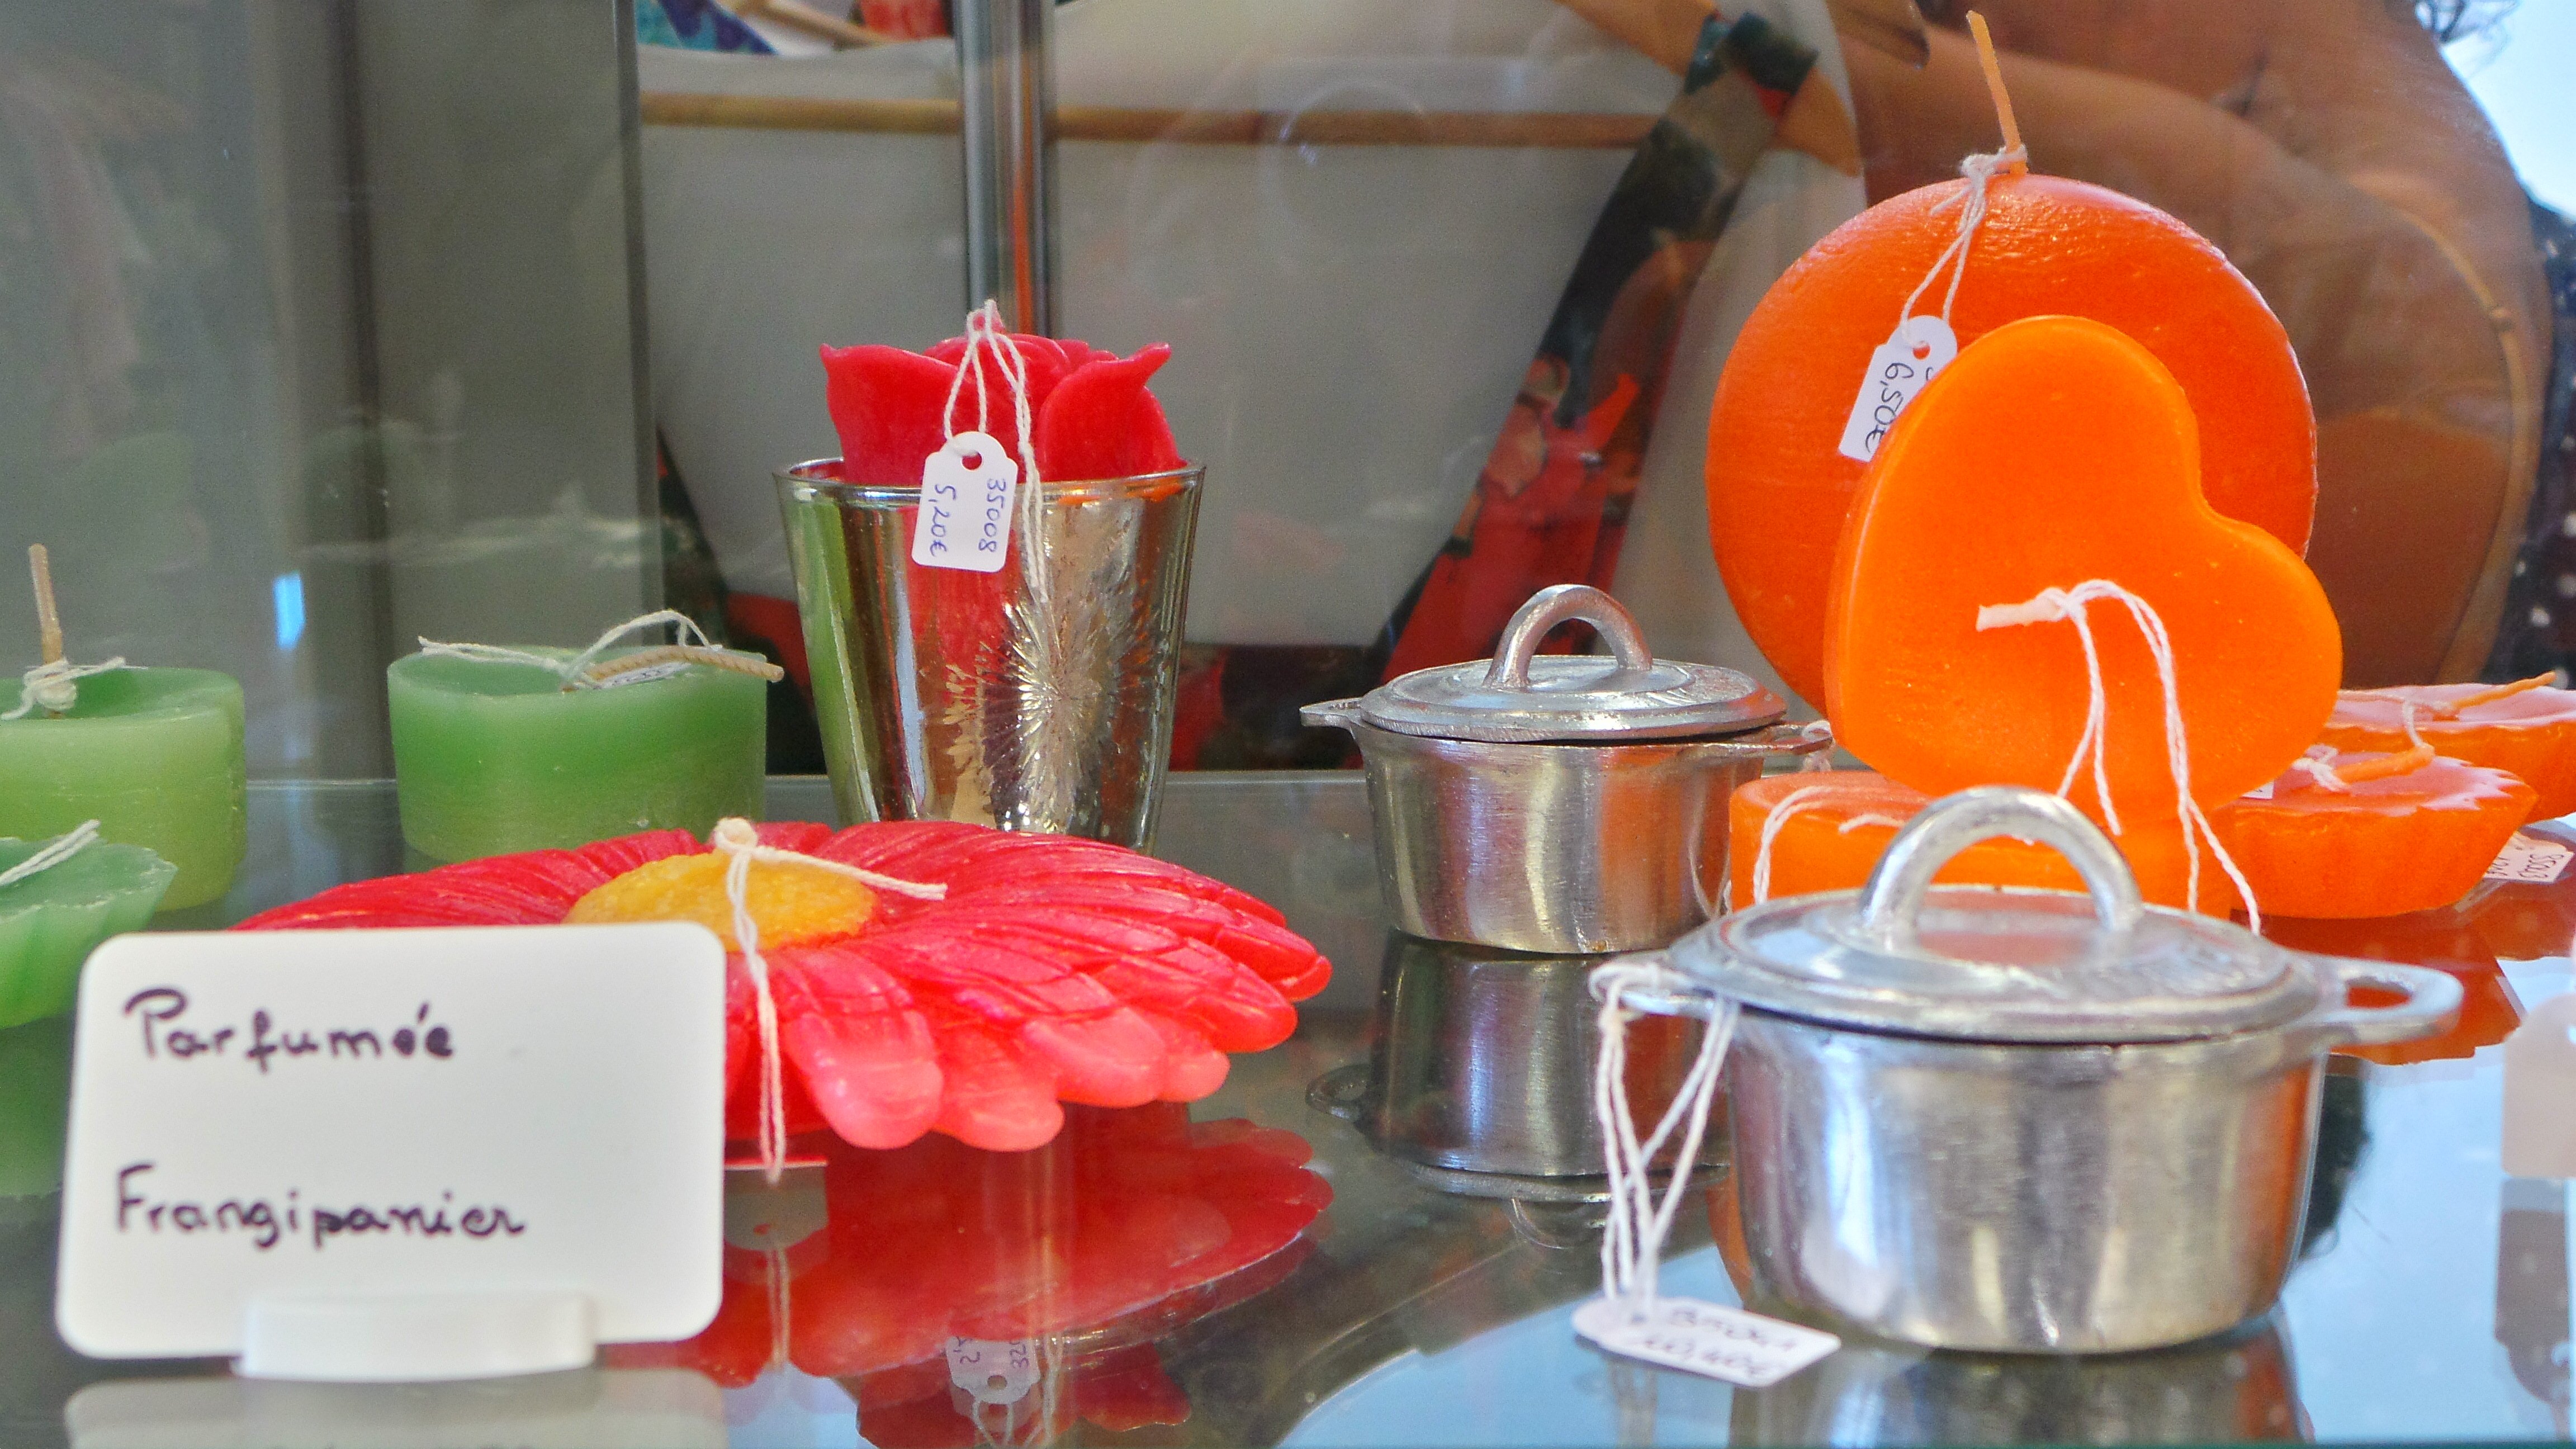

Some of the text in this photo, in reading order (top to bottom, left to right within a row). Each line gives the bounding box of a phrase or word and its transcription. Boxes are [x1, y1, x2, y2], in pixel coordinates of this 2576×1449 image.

[1865, 363, 1914, 453] 6,50€
[928, 484, 956, 557] 5,20€
[978, 478, 1006, 553] 35008
[123, 986, 456, 1074] Parfumée
[116, 1163, 527, 1250] Frangipanier
